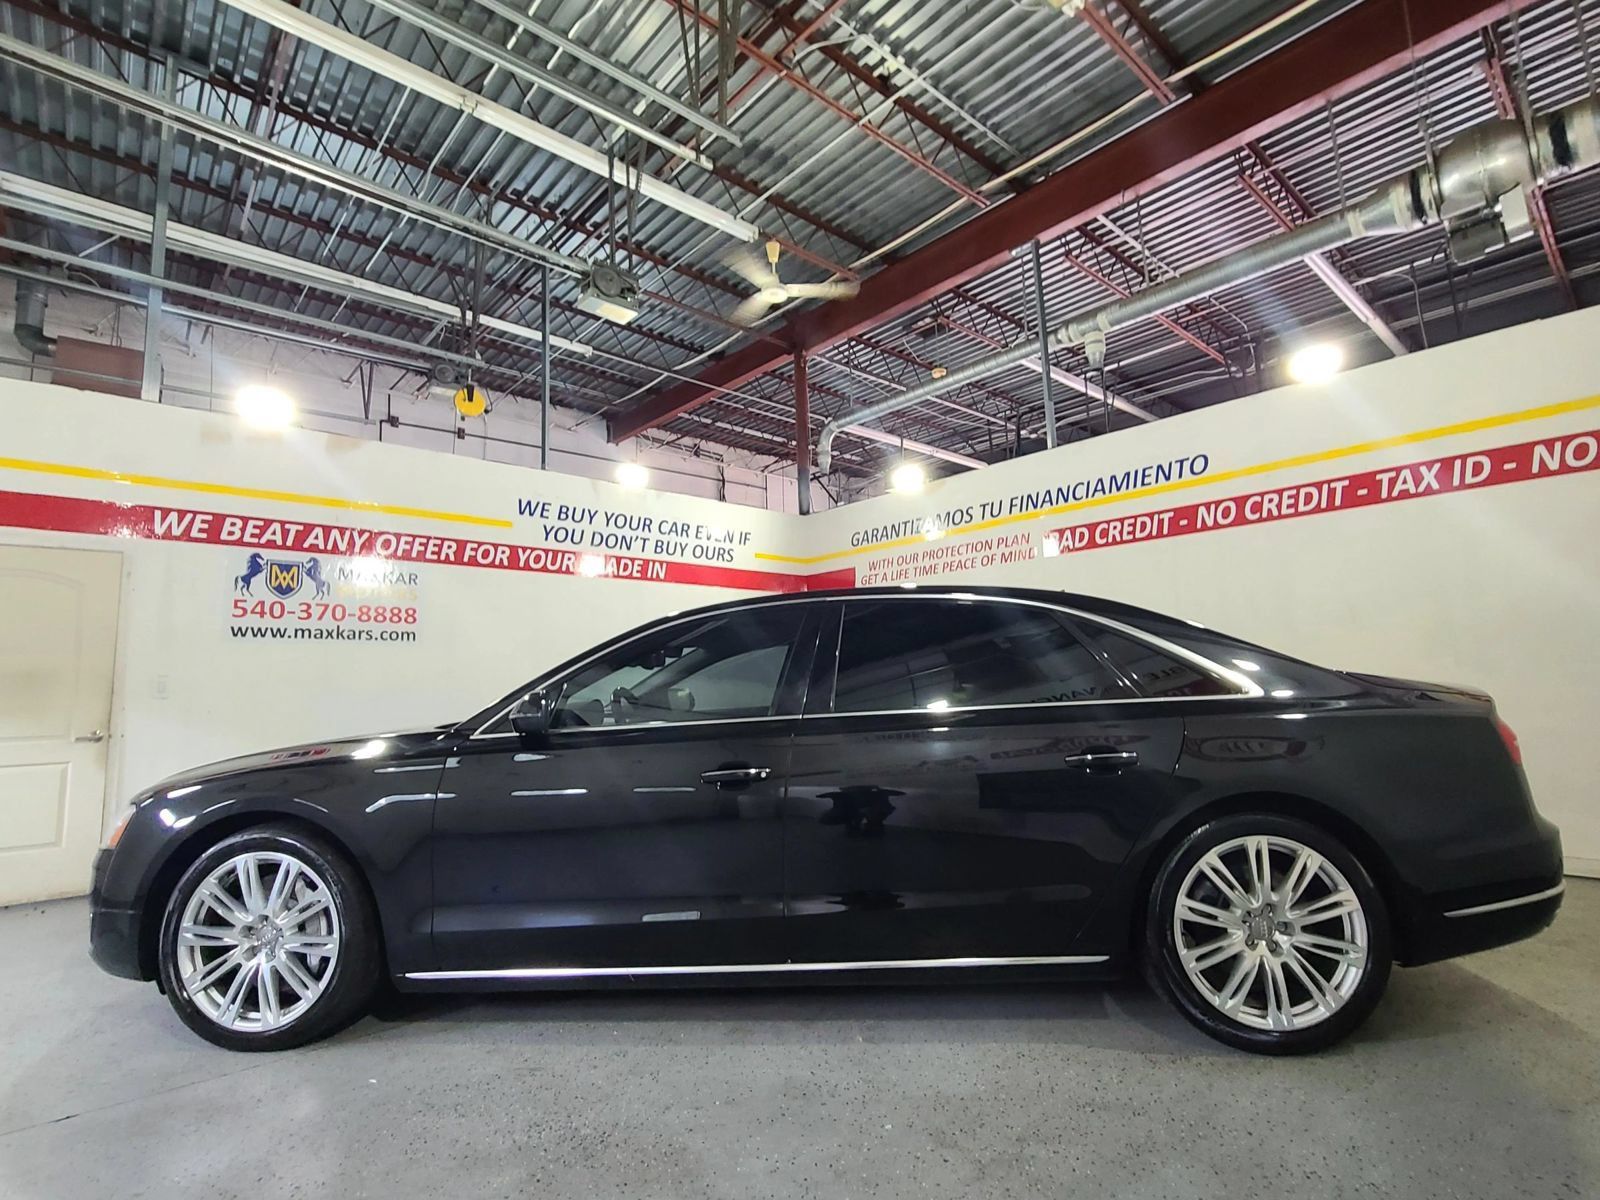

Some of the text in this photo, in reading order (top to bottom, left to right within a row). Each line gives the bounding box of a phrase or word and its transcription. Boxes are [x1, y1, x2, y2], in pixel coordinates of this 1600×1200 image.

[979, 500, 1003, 522] TU
[1008, 453, 1210, 514] FINANCIAMIENTO
[1094, 511, 1174, 545] CREDIT
[1196, 501, 1237, 527] NO
[1244, 480, 1349, 521] CREDIT
[1375, 463, 1442, 499] TAX
[1452, 455, 1492, 487] ID
[1502, 461, 1518, 471] -
[1531, 436, 1599, 474] NO
[518, 498, 552, 519] WE
[557, 505, 598, 525] BUY
[604, 512, 653, 533] YOUR
[658, 519, 692, 540] CAR
[739, 530, 752, 546] IF
[152, 510, 667, 580] WE BEAT ANY OFFER FOR YOUR ADE IN
[543, 525, 586, 544] YOU
[654, 539, 689, 559] BUY
[692, 544, 735, 563] OURS
[868, 532, 1030, 572] WITH OUR PROTECTION PLAN
[338, 566, 419, 586] MKAR
[860, 546, 1036, 586] GET A LIFE TIME PEACE OF MIND
[231, 599, 418, 624] 540-370-8888
[230, 625, 417, 642] www.maxkars.com
